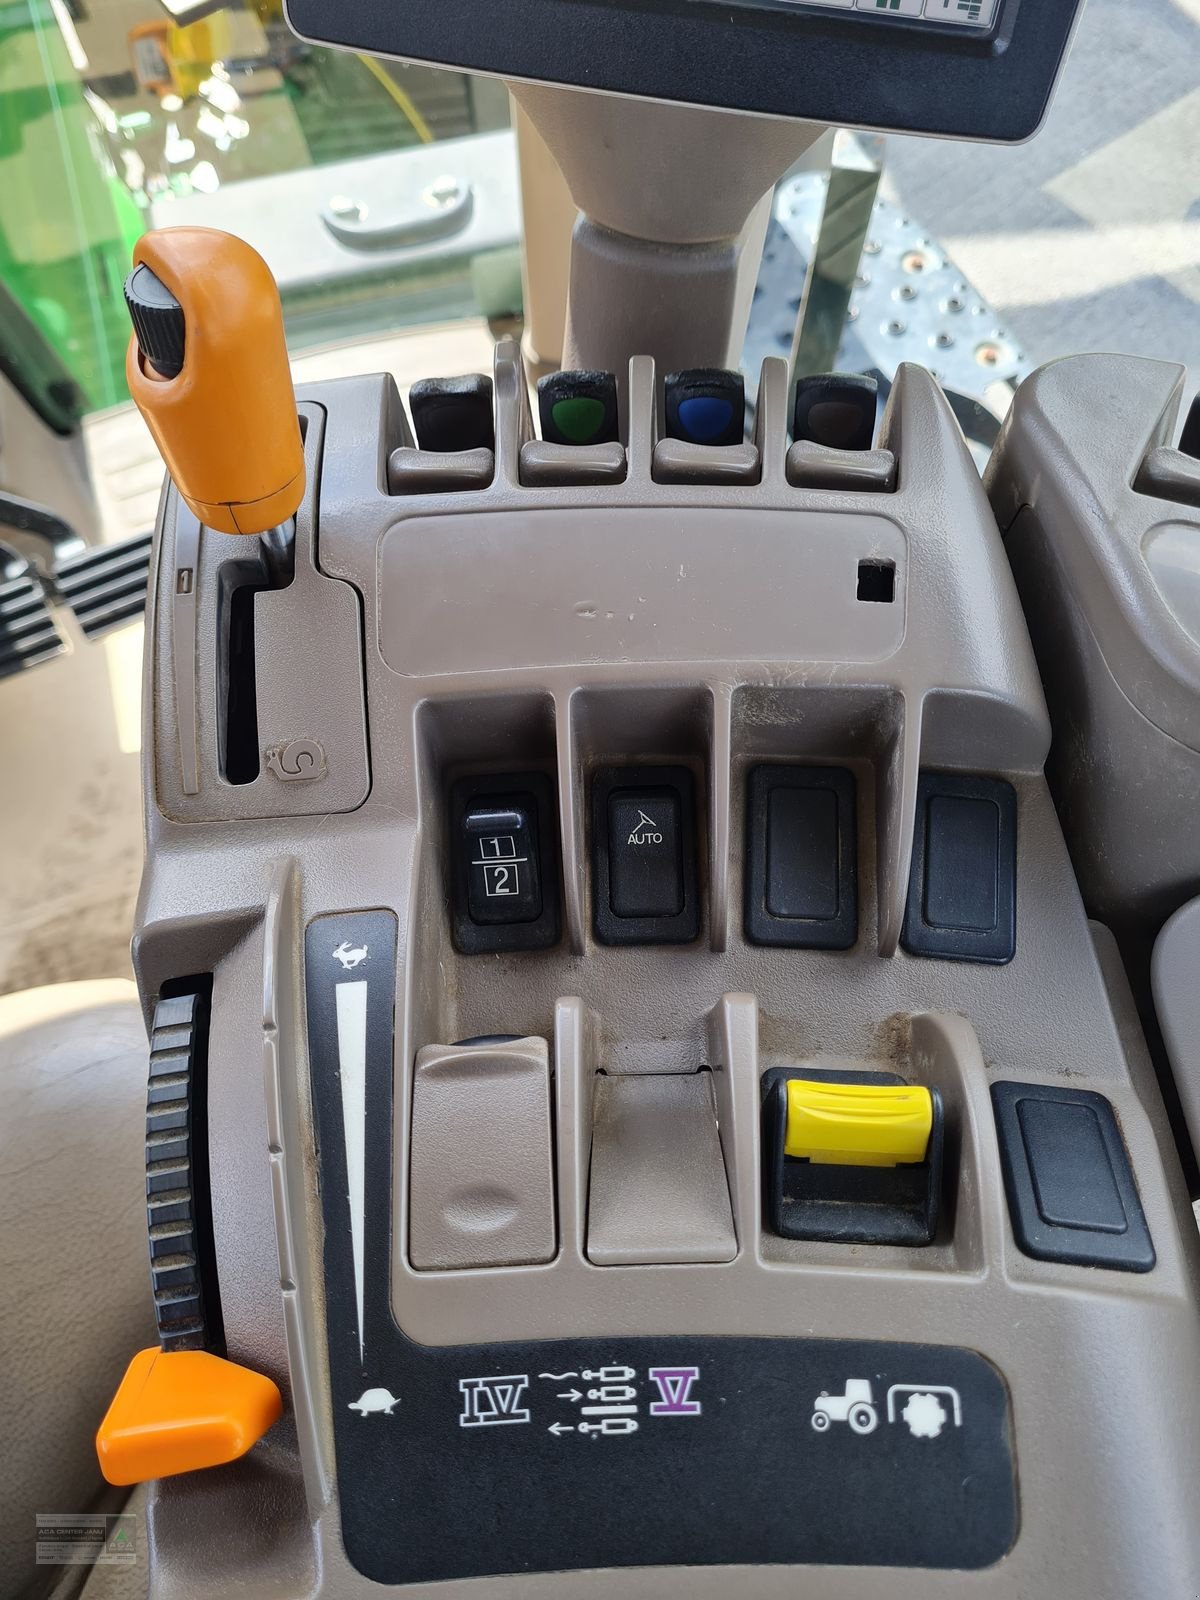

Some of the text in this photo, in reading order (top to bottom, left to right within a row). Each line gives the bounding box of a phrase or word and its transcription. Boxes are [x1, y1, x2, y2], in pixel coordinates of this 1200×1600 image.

[489, 837, 500, 857] 1
[627, 832, 663, 845] AUTO
[494, 867, 510, 894] 2
[459, 1374, 530, 1427] IV
[649, 1366, 701, 1416] V
